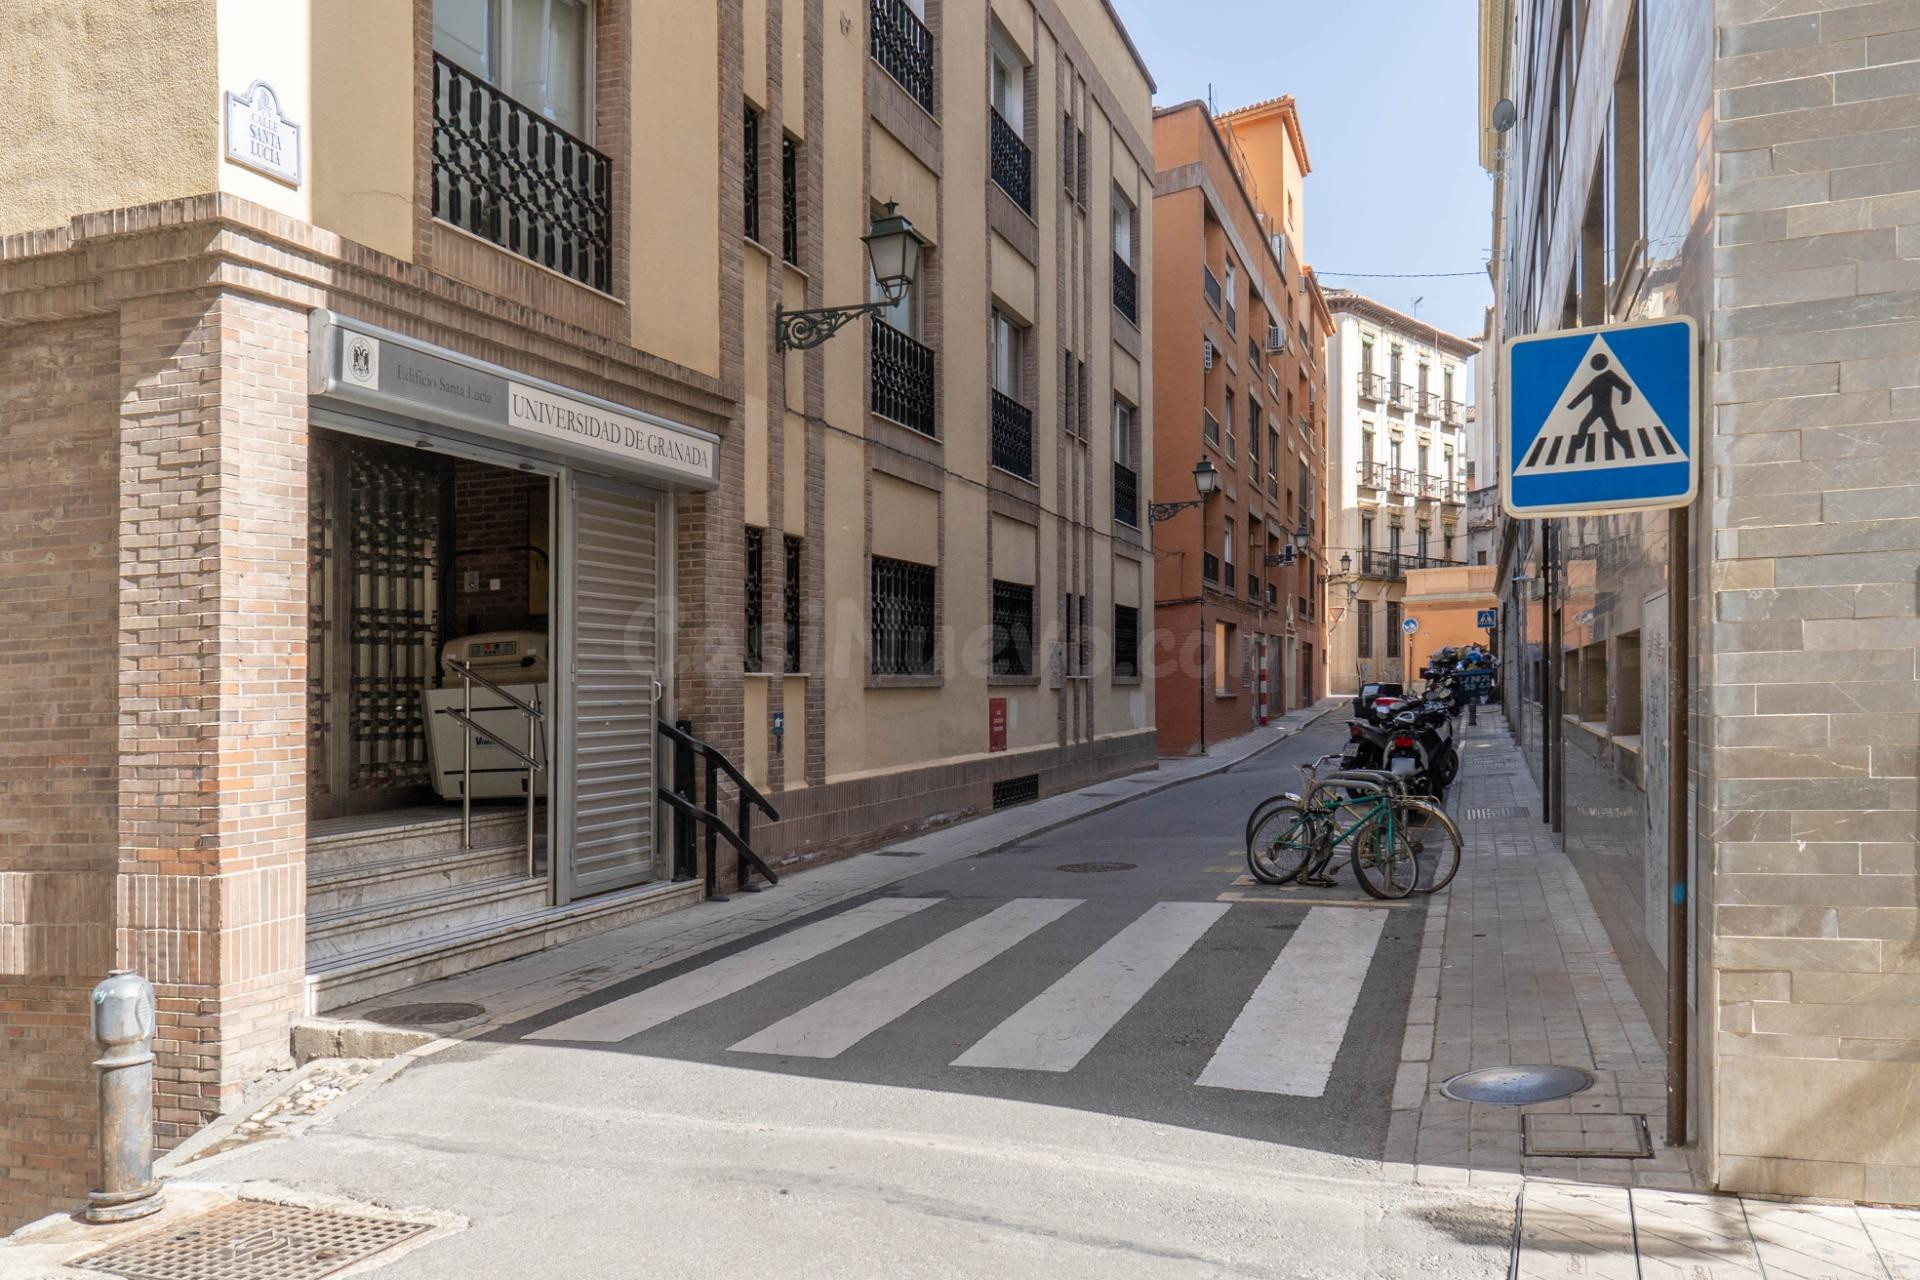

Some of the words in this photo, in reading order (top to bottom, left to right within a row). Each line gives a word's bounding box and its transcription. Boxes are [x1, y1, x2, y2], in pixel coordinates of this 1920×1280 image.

[249, 123, 282, 151] SANTA
[251, 112, 279, 132] CALLE
[396, 364, 437, 388] Edificio
[439, 376, 465, 397] Santa
[512, 394, 621, 444] UNIVERSIDAD
[624, 427, 644, 451] DE
[647, 434, 709, 469] GRANADA
